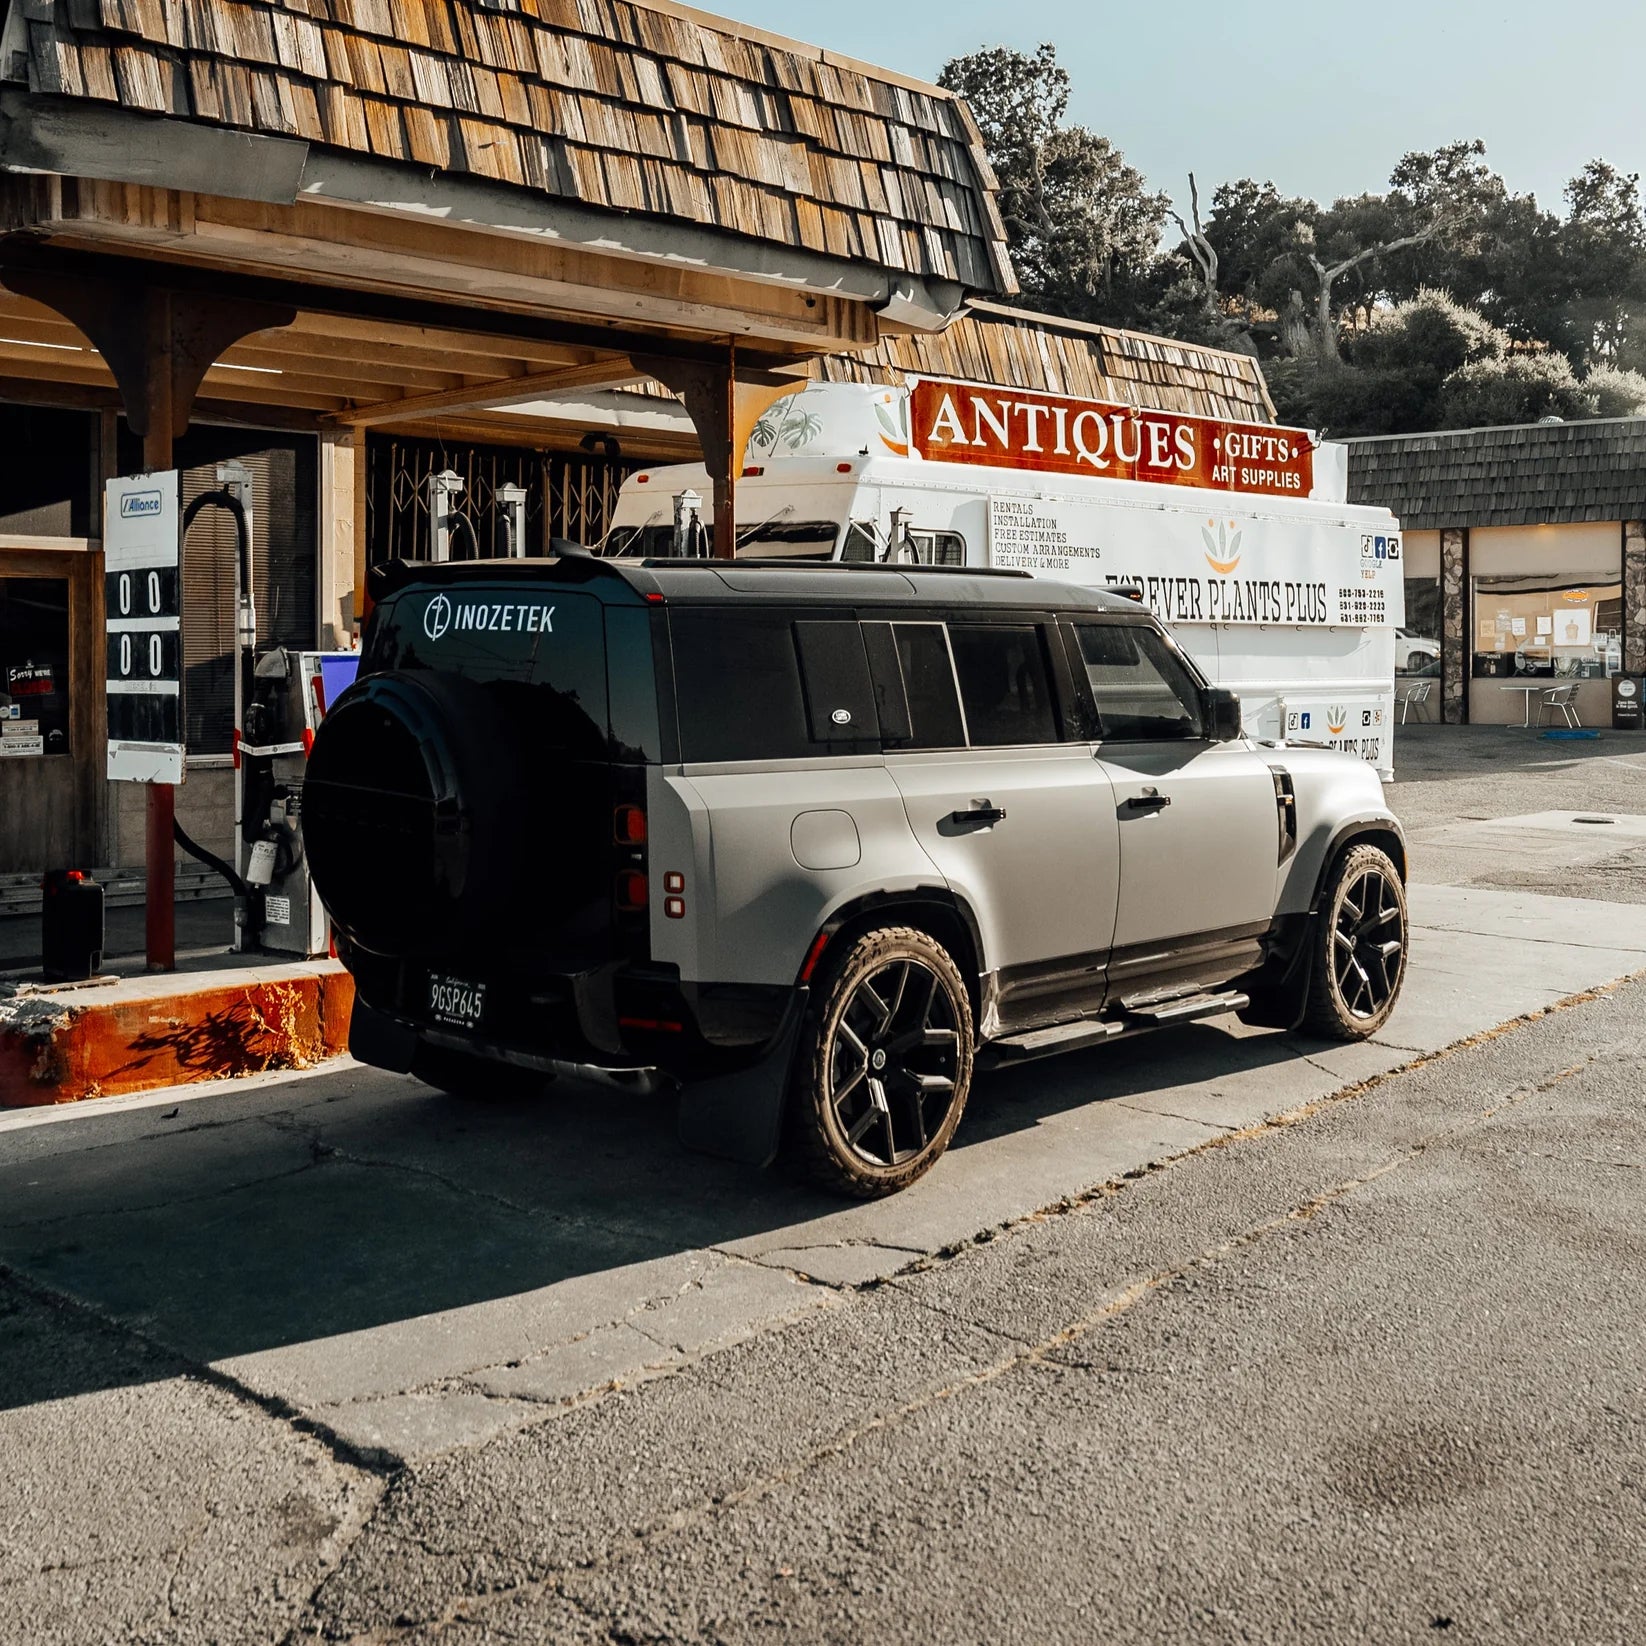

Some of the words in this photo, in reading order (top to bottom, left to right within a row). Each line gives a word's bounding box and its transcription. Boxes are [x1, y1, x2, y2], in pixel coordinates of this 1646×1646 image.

[927, 392, 1197, 471] ANTIQUES
[1211, 464, 1237, 483] ART
[1241, 467, 1301, 490] SUPPLIES
[128, 497, 160, 513] Alliance
[993, 501, 1034, 515] RENTALS
[993, 515, 1057, 530] INSTALLATION
[994, 528, 1017, 540] FREE
[1019, 530, 1067, 543] ESTIMATES
[995, 542, 1029, 555] CUSTOM
[1032, 544, 1101, 559] ARRANGEMENTS
[995, 556, 1038, 568] DELIVERY
[1046, 558, 1070, 570] MORE
[1207, 579, 1281, 622] PLANTS
[1285, 582, 1327, 623] PLUS
[454, 605, 556, 632] INOZETEK
[10, 669, 33, 681] Sorry
[1362, 738, 1379, 760] PLUS
[431, 983, 482, 1018] 9GSP645
